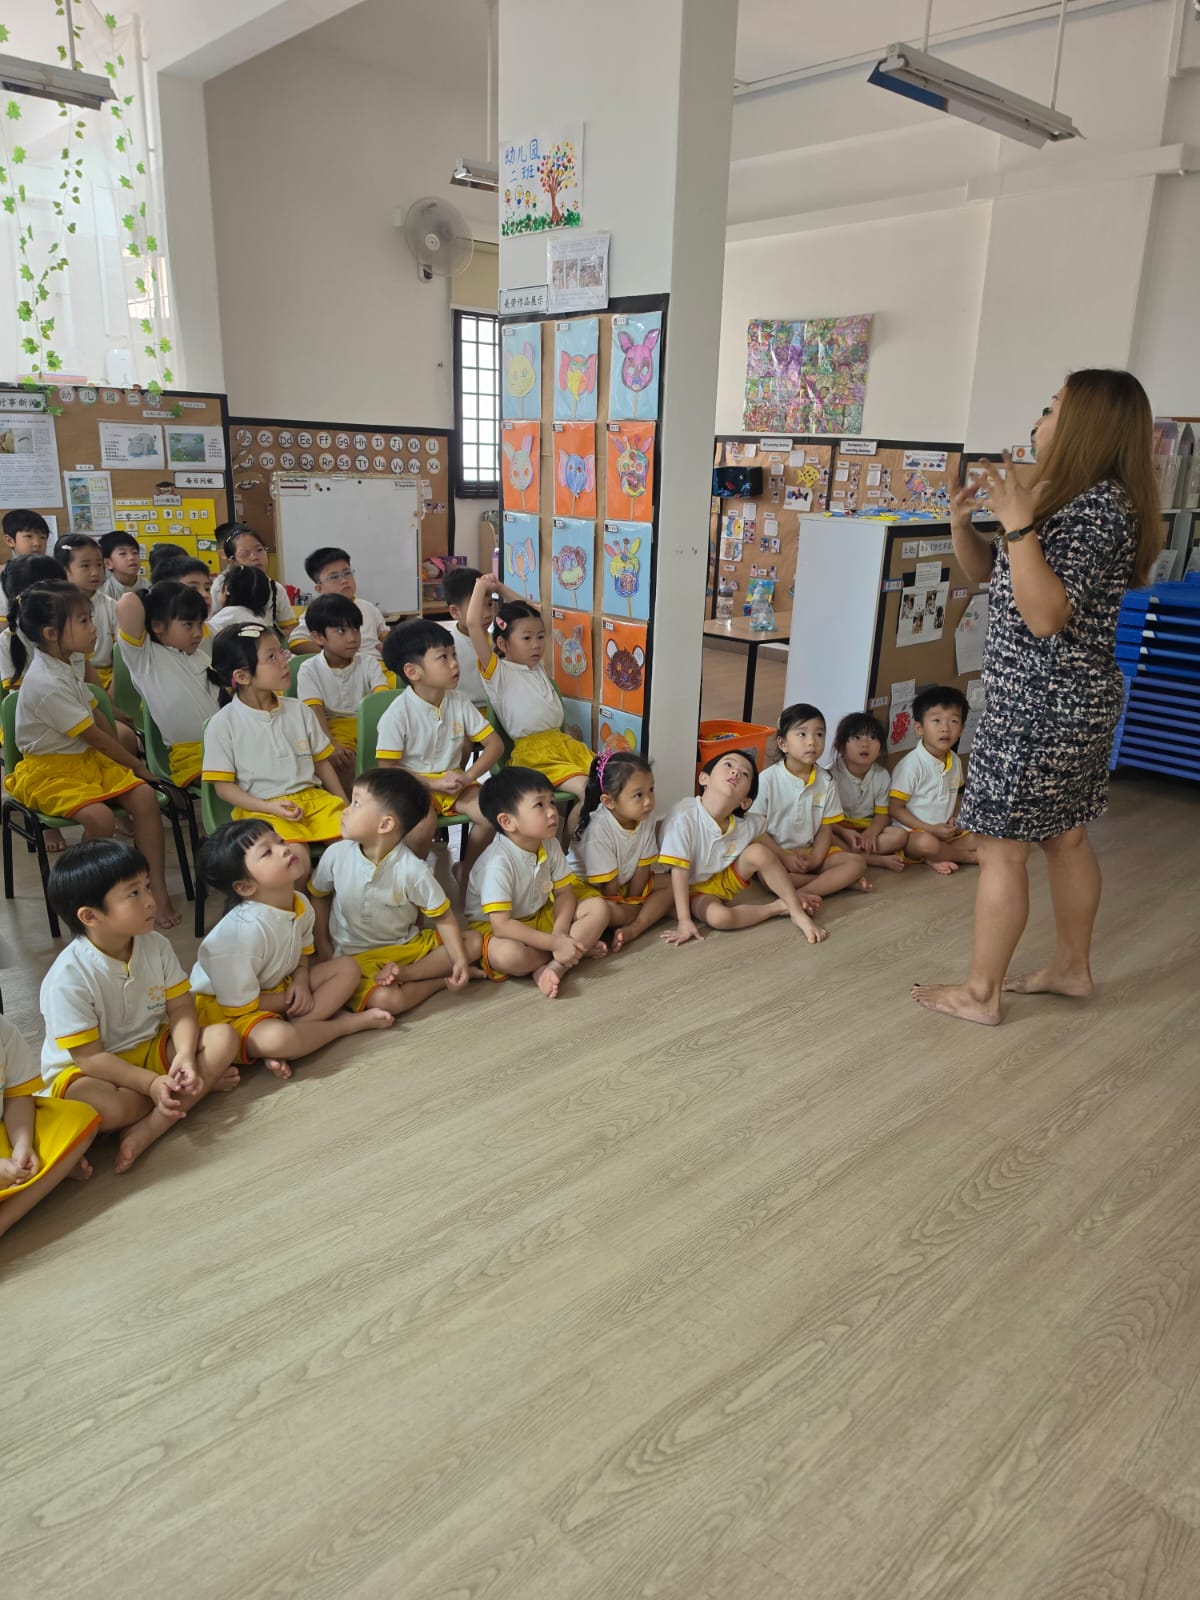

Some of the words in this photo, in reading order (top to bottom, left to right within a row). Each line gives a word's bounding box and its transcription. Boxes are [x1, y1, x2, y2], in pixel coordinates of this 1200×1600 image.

[505, 138, 540, 166] 幼儿园
[510, 165, 535, 182] 二班
